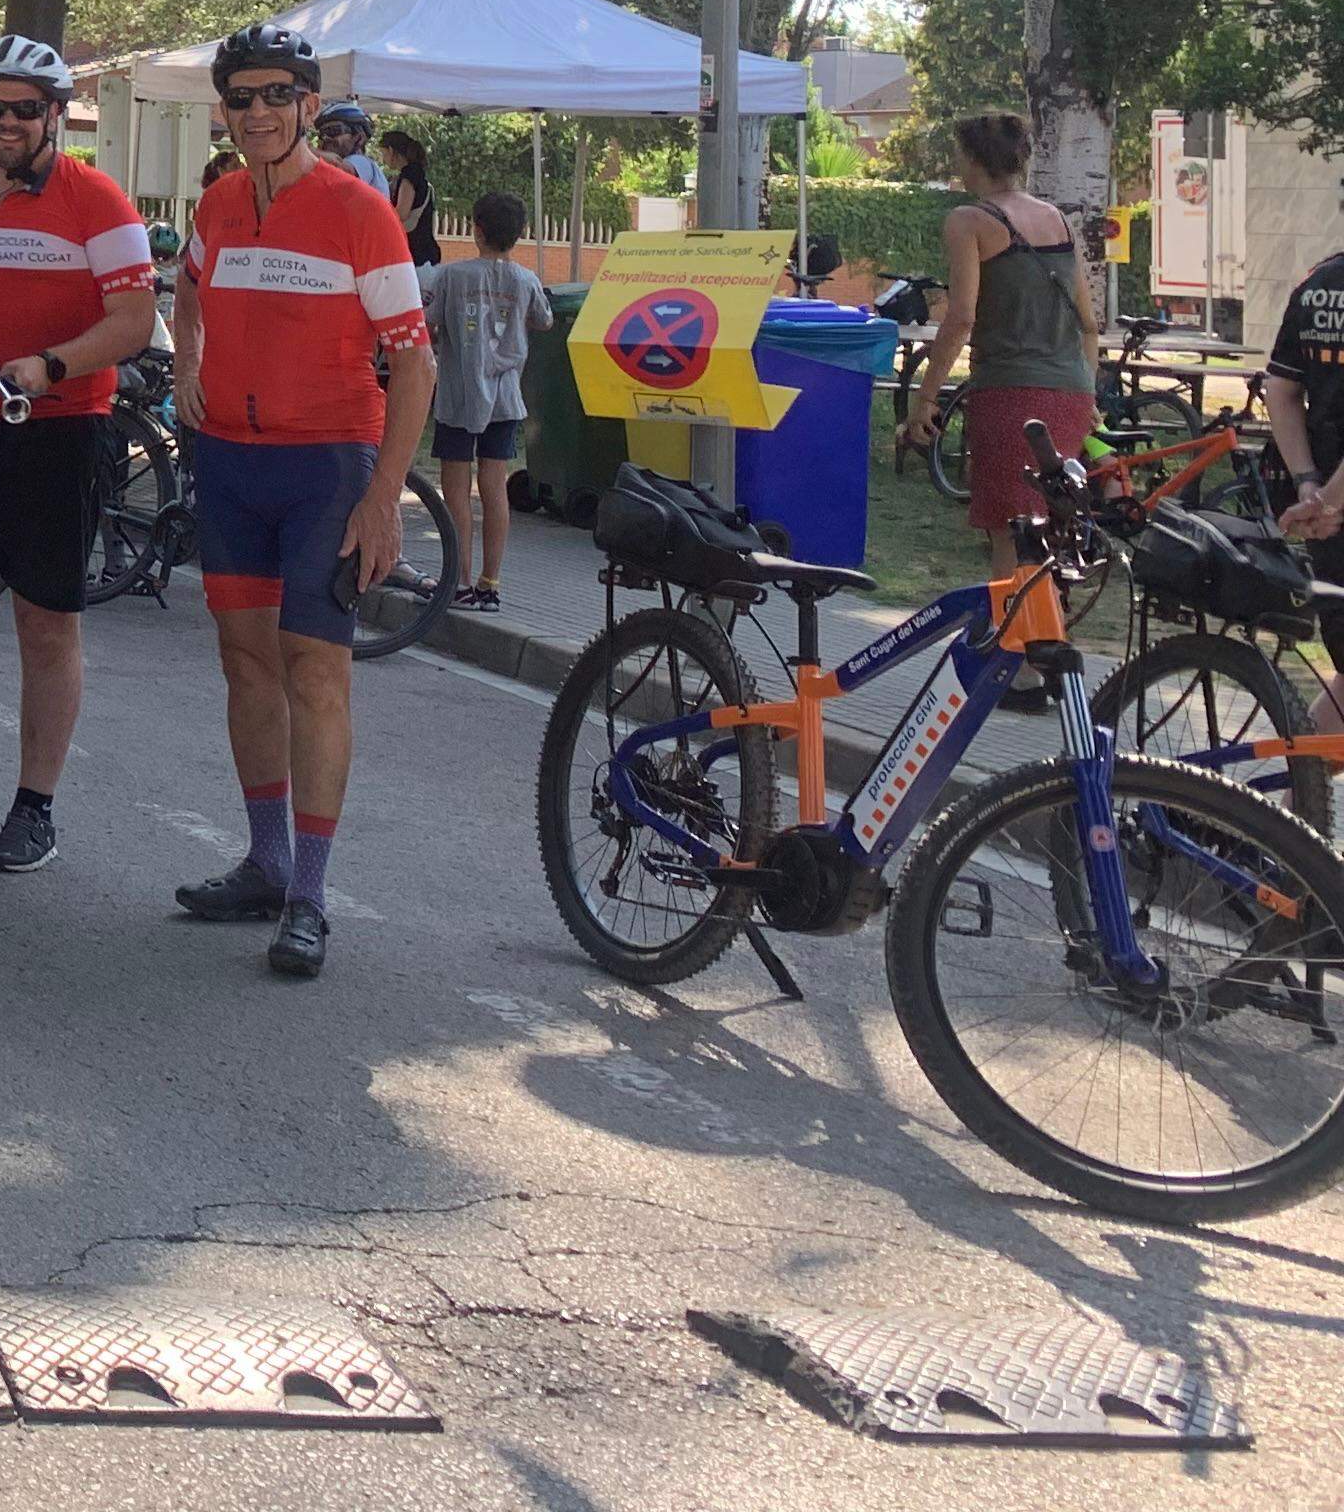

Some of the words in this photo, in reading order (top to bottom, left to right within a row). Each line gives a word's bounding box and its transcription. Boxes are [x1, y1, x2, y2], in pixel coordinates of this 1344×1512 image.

[27, 252, 72, 263] CUGAT
[613, 247, 677, 258] Ajuntament
[679, 247, 692, 257] de
[224, 254, 251, 267] UNIÓ
[262, 258, 307, 273] CICLISTA
[258, 273, 286, 285] SANT
[599, 270, 687, 286] Senyalització
[690, 273, 774, 288] excepcional
[848, 652, 871, 673] Sant
[870, 634, 898, 659] Cugat
[897, 623, 914, 641] del
[912, 605, 942, 629] Vallès
[868, 724, 916, 802] protecció
[915, 690, 938, 726] civil
